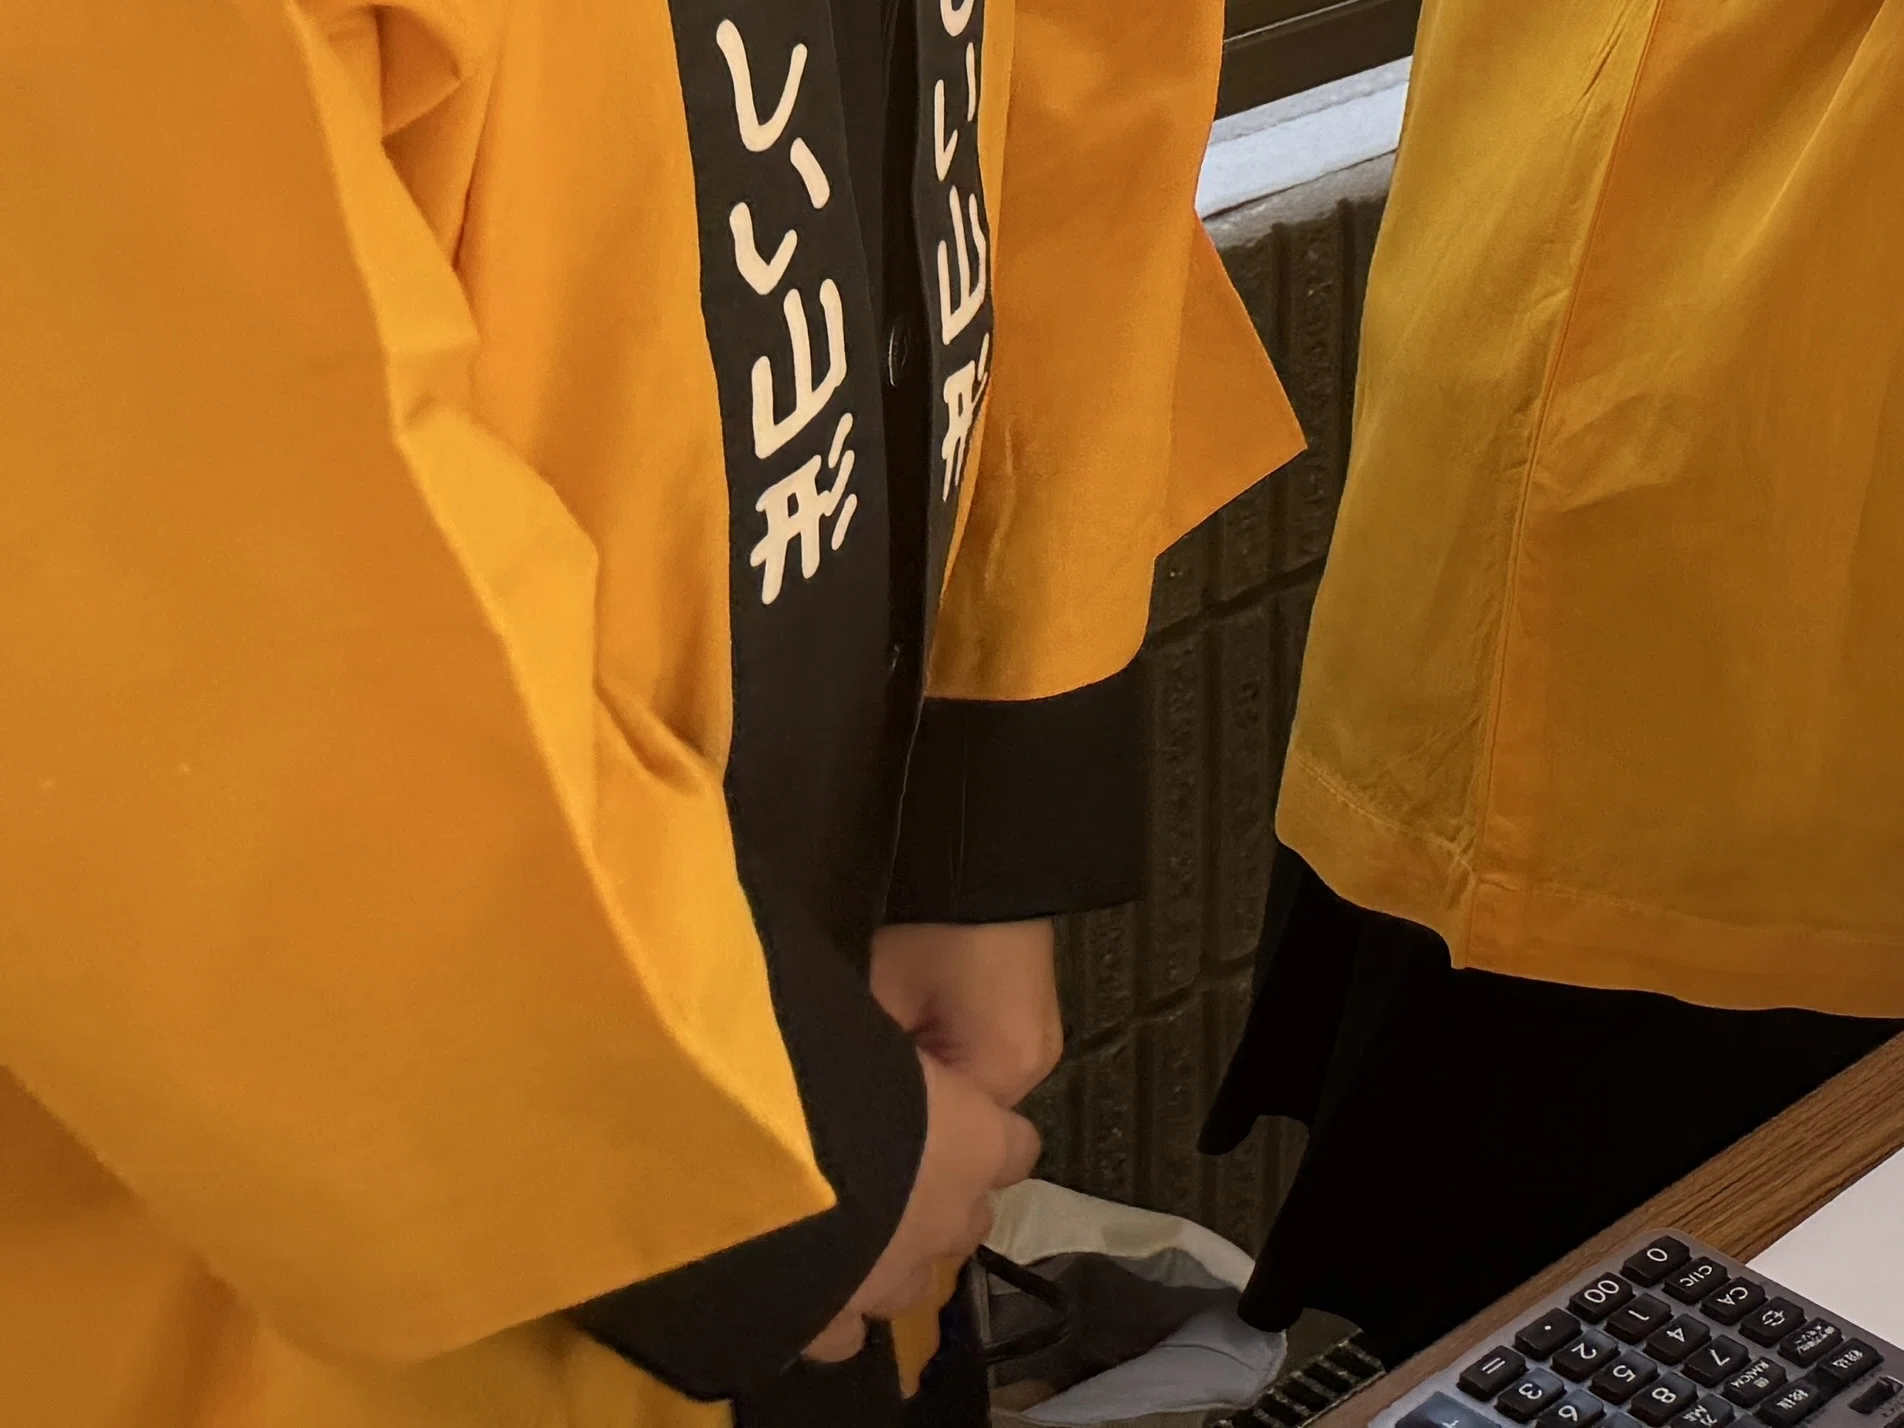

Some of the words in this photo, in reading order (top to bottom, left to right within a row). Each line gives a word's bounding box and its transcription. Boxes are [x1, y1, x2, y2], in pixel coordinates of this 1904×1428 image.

[1717, 1286, 1748, 1306] CA
[1666, 1325, 1686, 1343] 4
[1571, 1342, 1597, 1360] 2
[1709, 1349, 1730, 1366] 7
[1612, 1364, 1637, 1384] 5
[1517, 1382, 1542, 1401] 3
[1651, 1387, 1676, 1405] 8
[1558, 1404, 1579, 1422] 6
